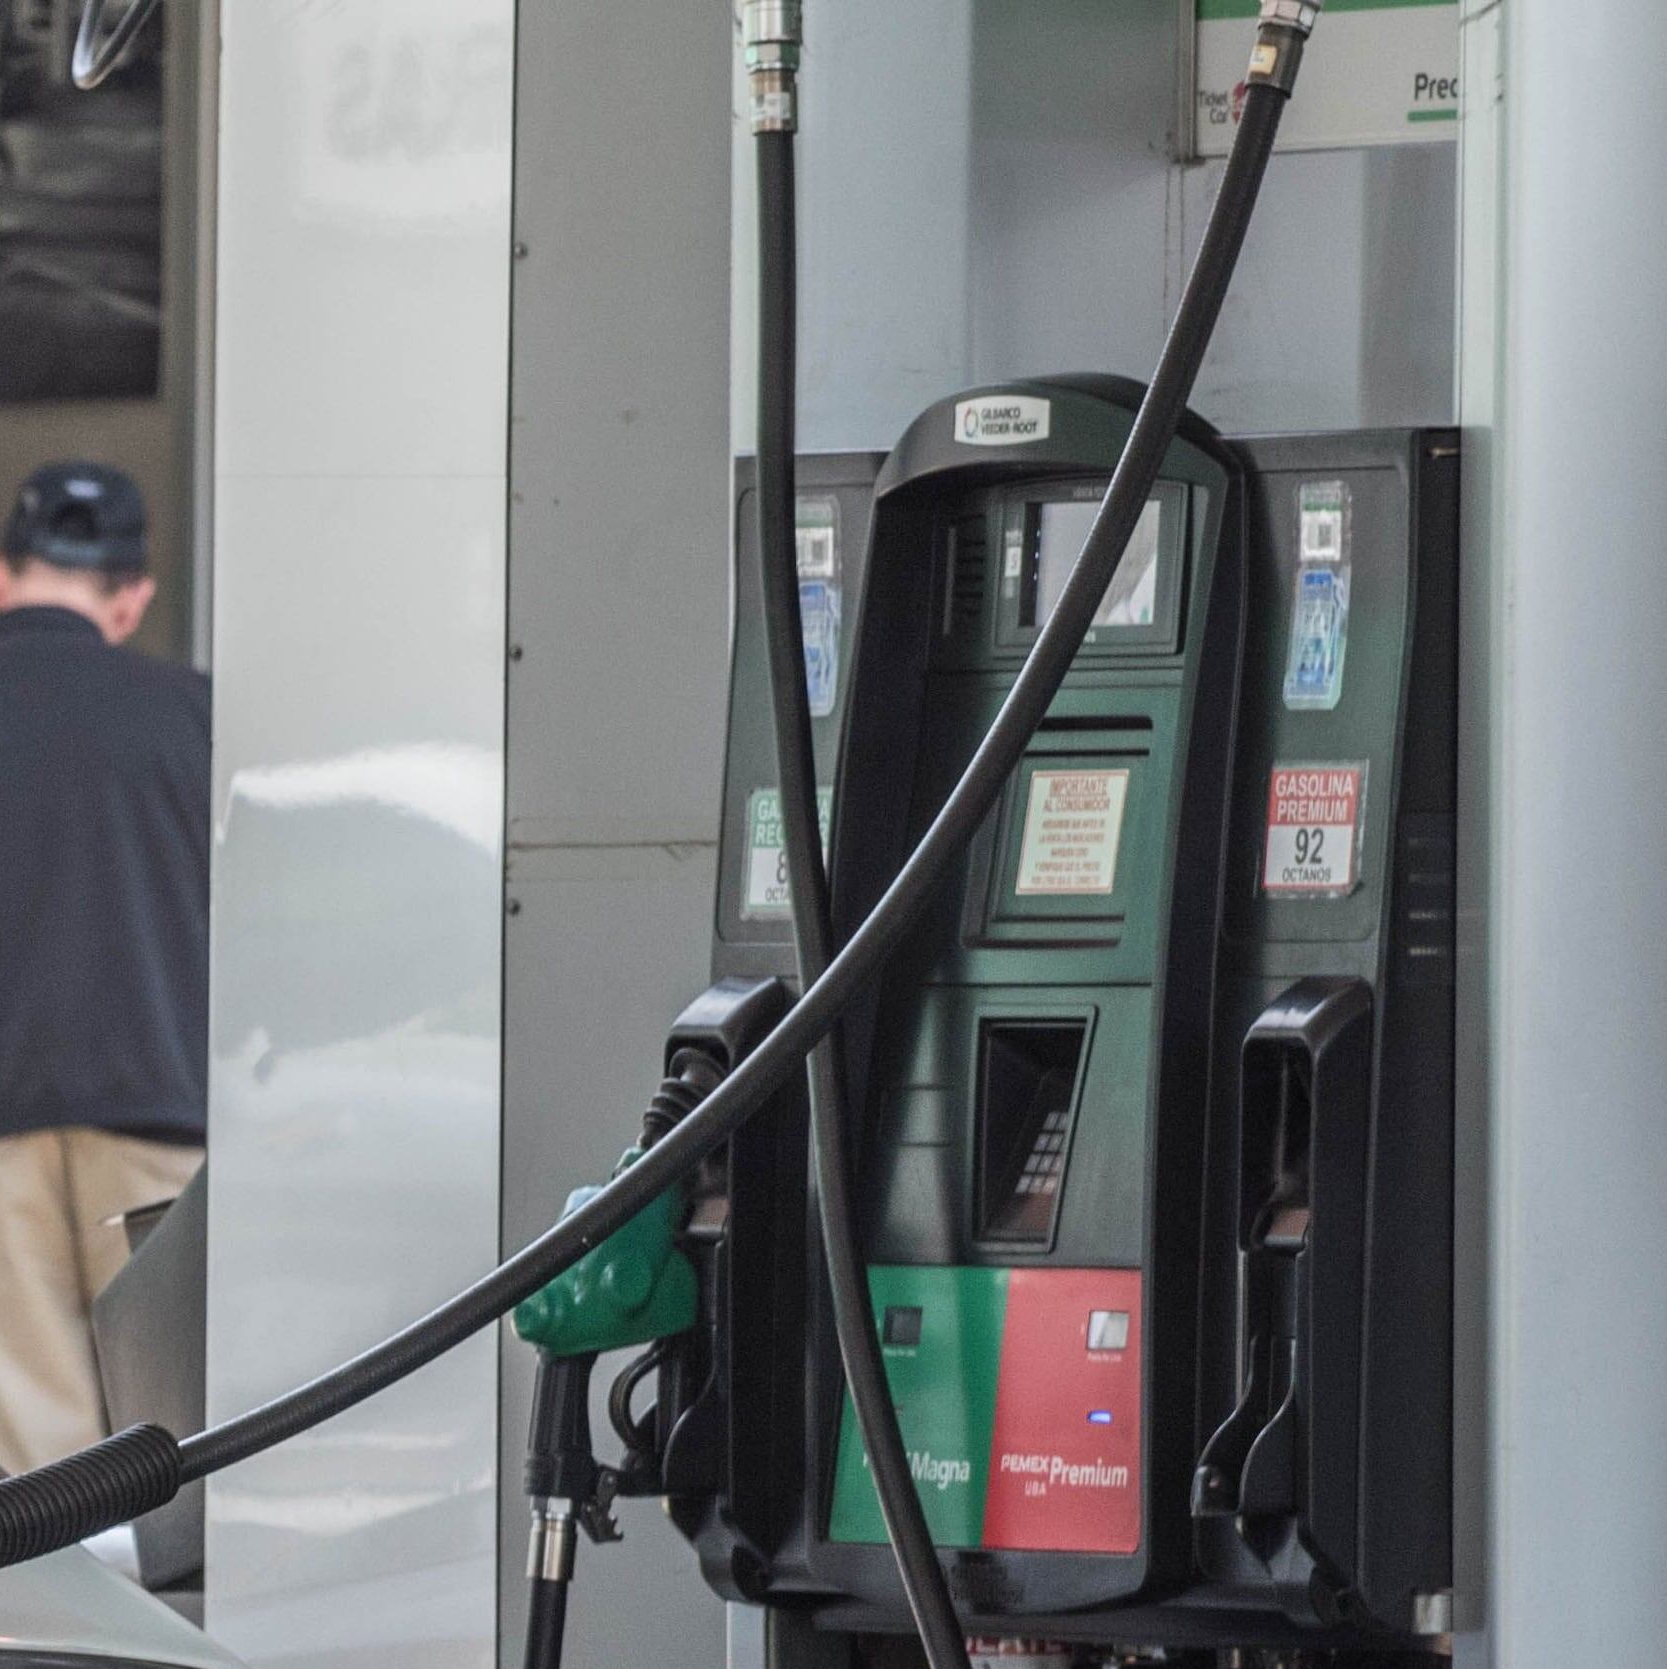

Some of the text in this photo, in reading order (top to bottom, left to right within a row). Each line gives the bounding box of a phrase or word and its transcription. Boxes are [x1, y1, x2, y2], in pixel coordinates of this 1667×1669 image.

[1275, 773, 1354, 797] GASOLINA
[1277, 799, 1348, 822] PREMIUM
[1295, 827, 1324, 865] 92
[1282, 867, 1331, 883] OCTANOS
[912, 1453, 970, 1490] Magna
[1000, 1454, 1129, 1489] PEMEX Premium
